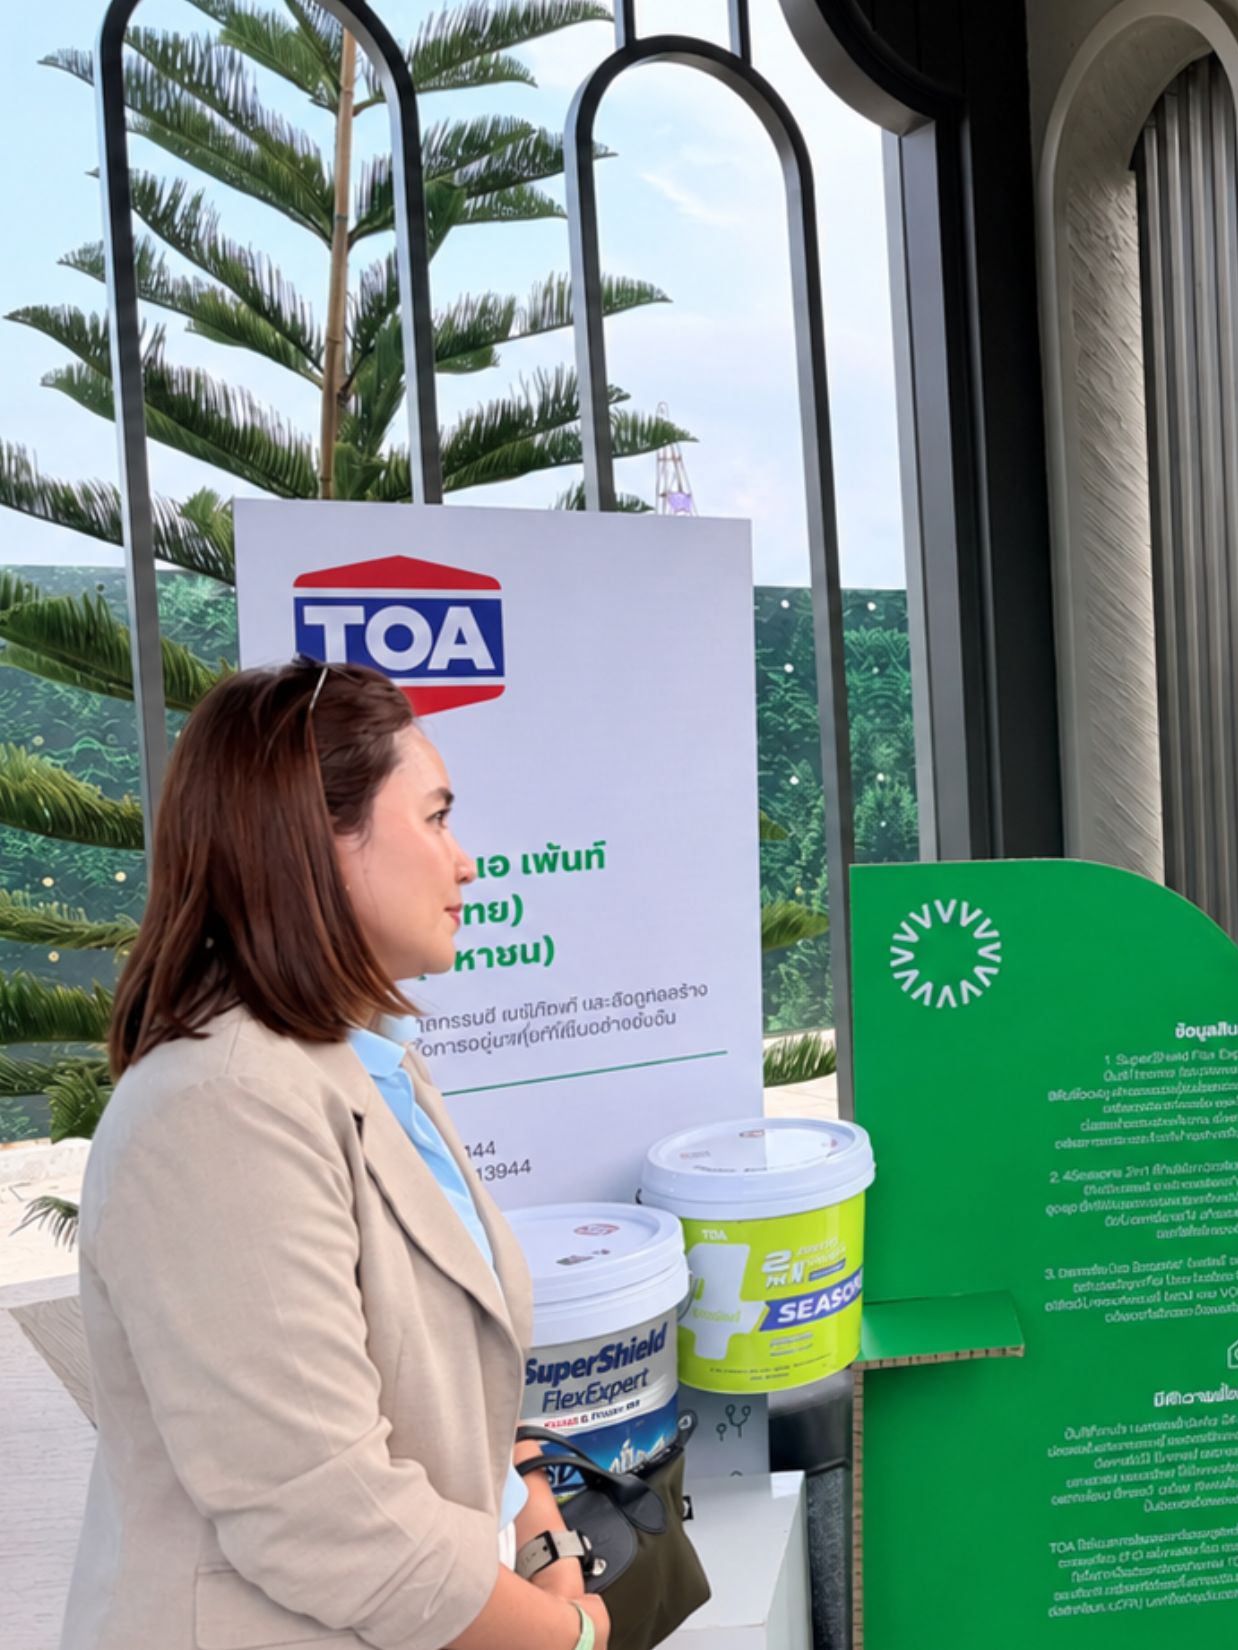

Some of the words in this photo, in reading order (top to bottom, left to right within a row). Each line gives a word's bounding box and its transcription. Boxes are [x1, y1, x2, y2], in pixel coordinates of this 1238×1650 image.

[303, 605, 496, 671] TOA
[476, 854, 511, 879] เอ
[463, 893, 524, 928] ทย)
[454, 934, 555, 972] หาชน)
[525, 1320, 668, 1388] SuperShield
[542, 1368, 650, 1413] FlexExpert
